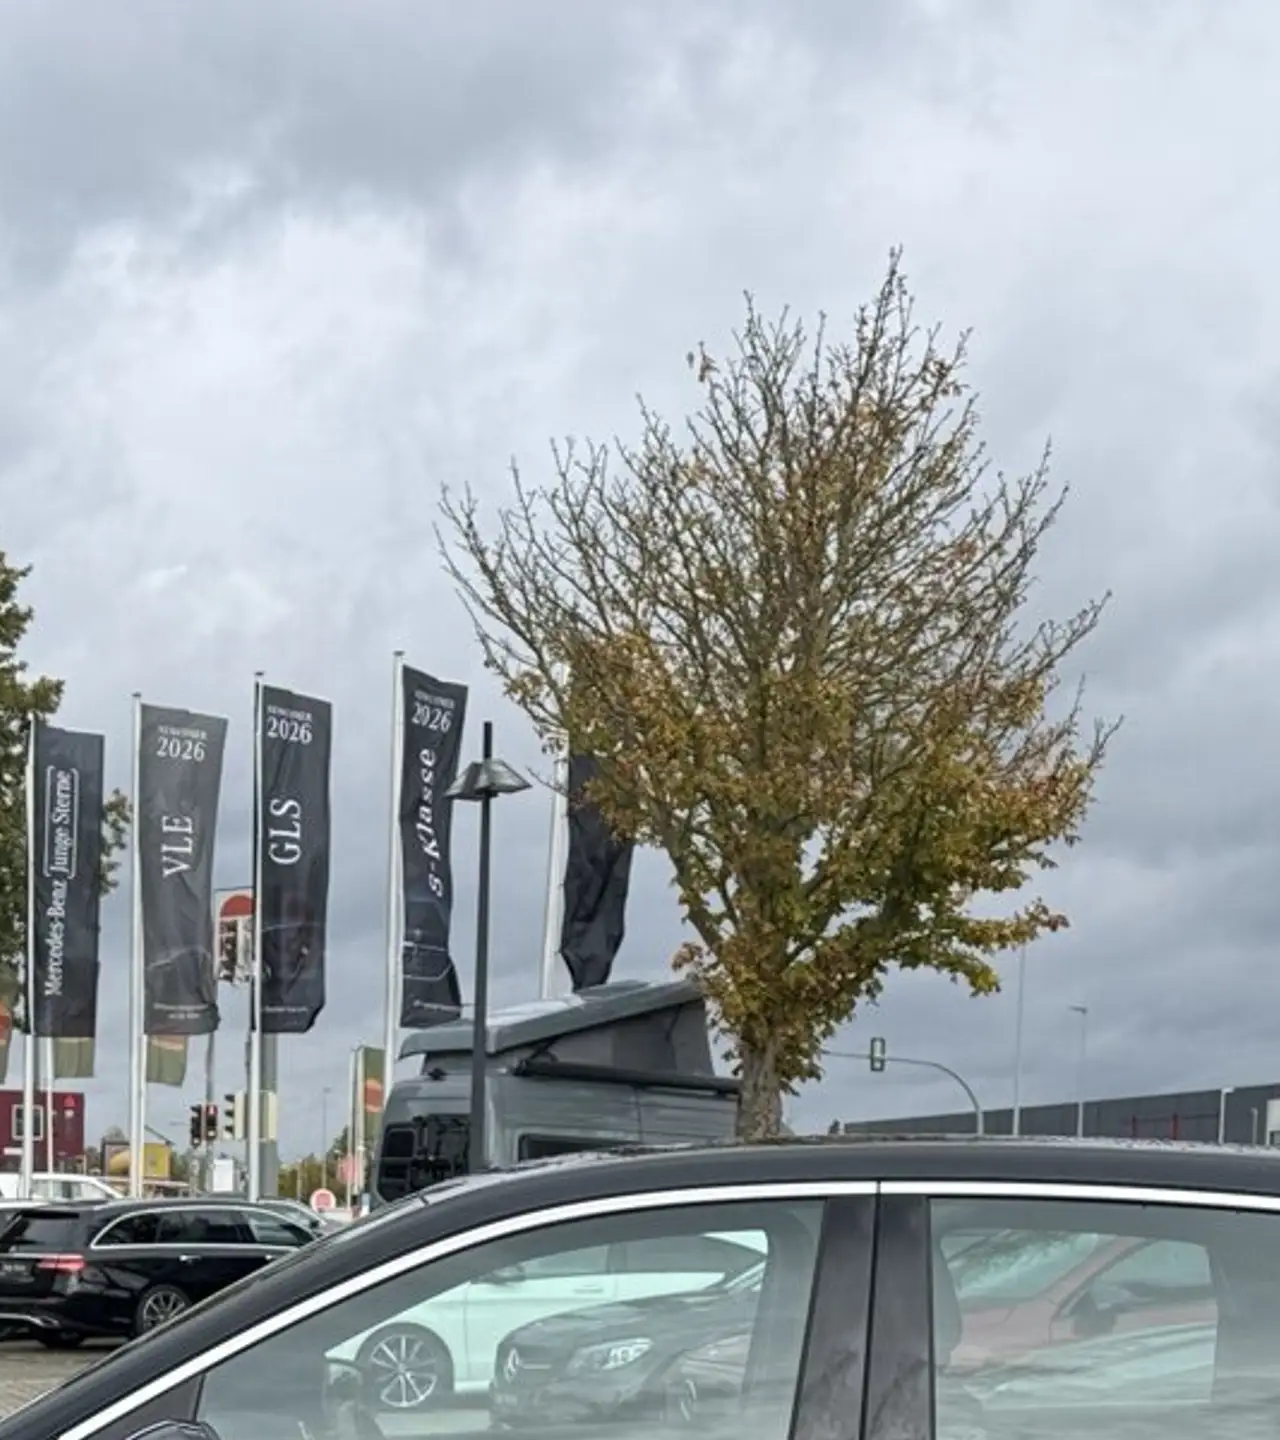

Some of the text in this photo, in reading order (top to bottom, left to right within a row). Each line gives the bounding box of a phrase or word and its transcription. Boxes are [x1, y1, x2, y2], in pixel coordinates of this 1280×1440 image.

[267, 716, 313, 745] 2026
[411, 702, 453, 732] 2026
[156, 736, 207, 762] 2026
[50, 770, 73, 874] Junge Sterne
[160, 815, 193, 878] VLE
[268, 799, 302, 865] GLS
[43, 880, 68, 996] Mercedes-Benz
